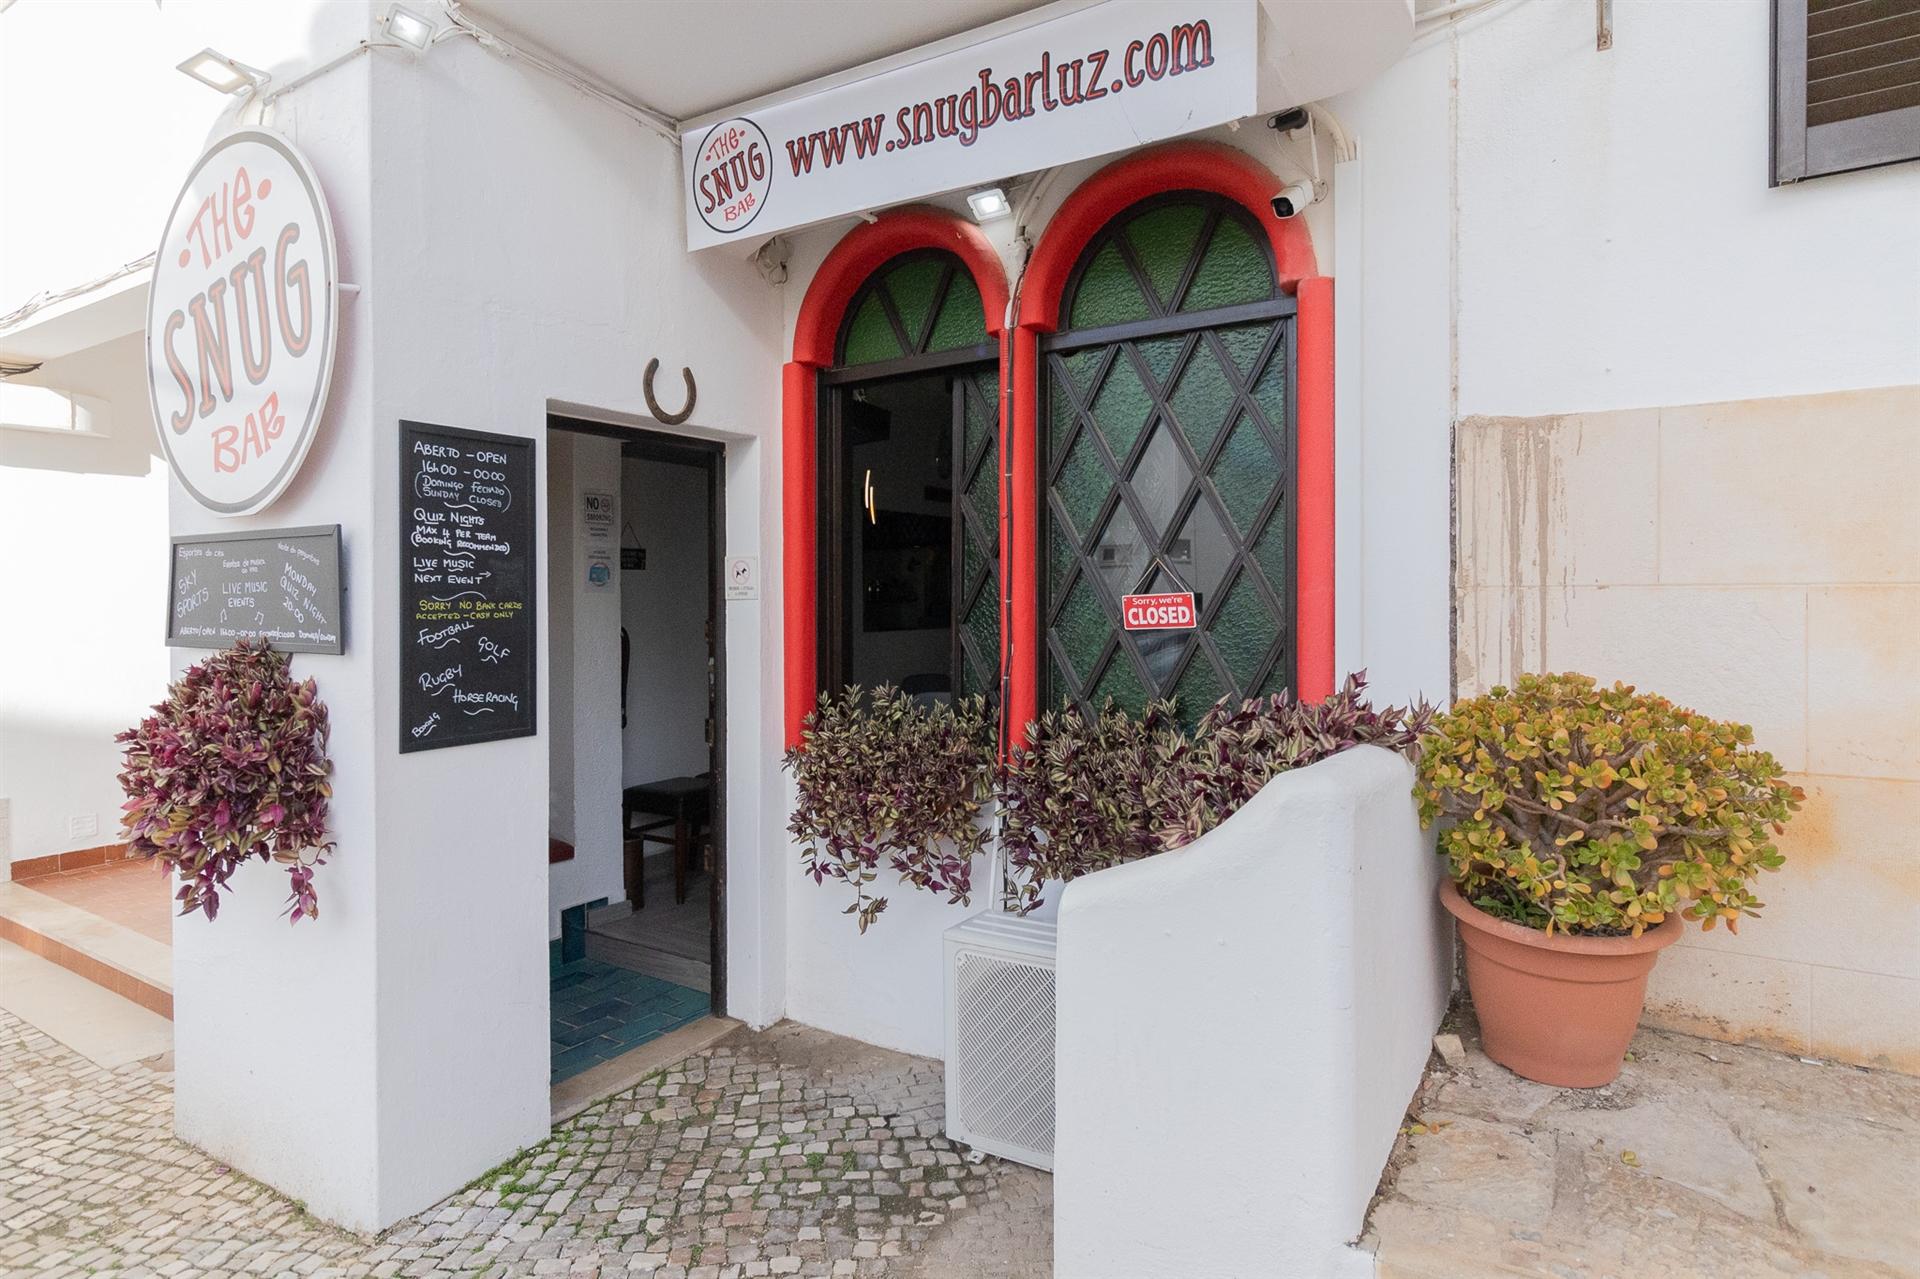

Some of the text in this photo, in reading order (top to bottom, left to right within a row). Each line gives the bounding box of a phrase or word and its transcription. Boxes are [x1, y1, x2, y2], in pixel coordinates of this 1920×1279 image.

[785, 19, 1215, 177] www.snugbarluz.com
[699, 142, 765, 214] SNUG
[723, 192, 756, 222] BAR
[163, 222, 313, 436] SNUG
[211, 391, 286, 473] BAR
[414, 440, 460, 459] ABERTO
[476, 451, 507, 465] OPEN
[586, 496, 600, 510] NO
[413, 507, 485, 526] QUIZ NIGHTS
[455, 528, 471, 538] PER
[413, 557, 475, 569] LIVE MUSIC
[178, 569, 197, 595] SKY
[222, 581, 268, 594] LIVE MUSIC
[284, 562, 317, 597] MONDAY
[447, 574, 483, 585] EVENT
[176, 587, 209, 618] SPORTS
[228, 596, 255, 608] EVENTS
[303, 597, 327, 624] NIGHT
[419, 599, 452, 611] SORRY
[459, 601, 472, 610] NO
[1132, 596, 1183, 606] Sorry, we're
[493, 611, 514, 619] ONLY
[1128, 606, 1191, 625] CLOSED
[417, 621, 475, 646] FOOTBALL
[478, 636, 511, 658] GOLF
[418, 663, 463, 691] RUGBY
